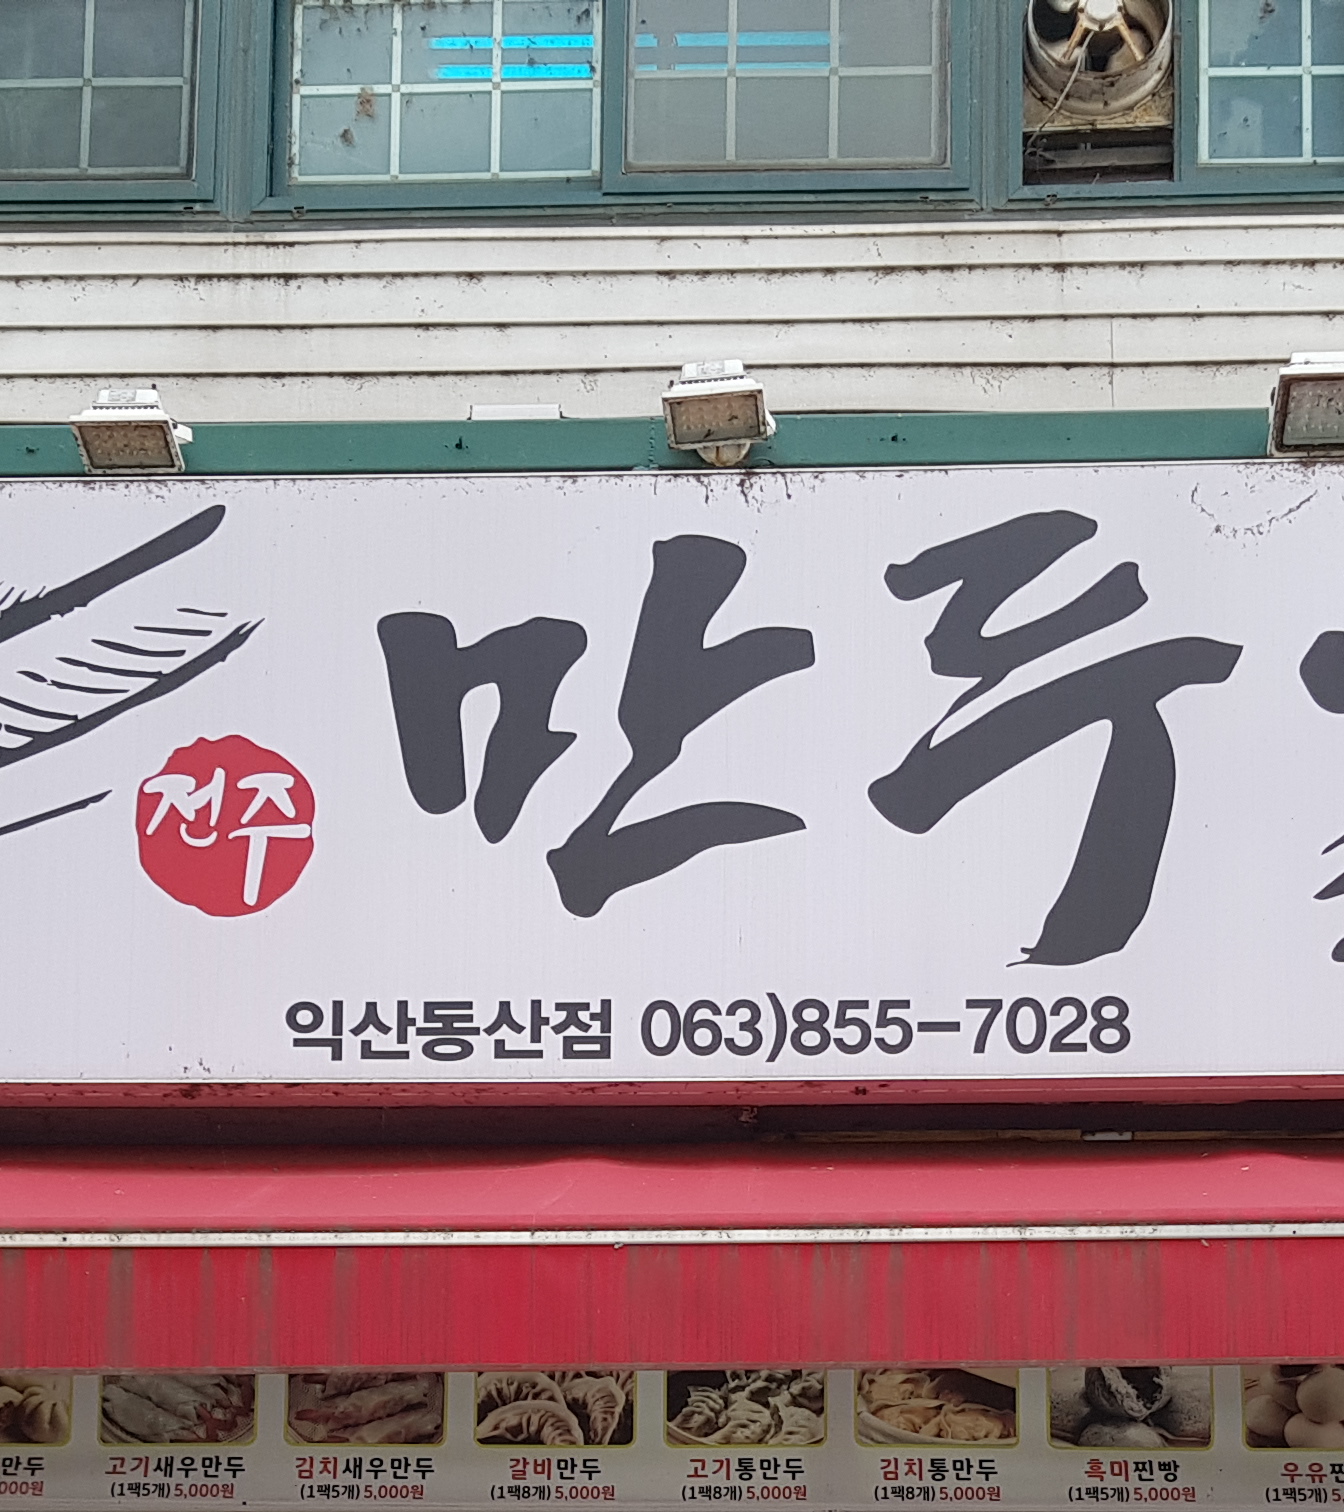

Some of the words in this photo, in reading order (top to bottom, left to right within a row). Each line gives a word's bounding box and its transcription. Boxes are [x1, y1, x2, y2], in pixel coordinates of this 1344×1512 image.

[145, 767, 311, 907] 전주
[286, 999, 611, 1061] 익산동산점
[641, 993, 1130, 1062] 063)855-7028
[105, 1456, 245, 1478] 고기새우만두
[296, 1456, 434, 1479] 김치새우만두
[510, 1457, 601, 1480] 갈비만두
[687, 1457, 804, 1481] 고기통만두
[881, 1458, 998, 1481] 김치통만두
[1085, 1459, 1180, 1482] 흑미찐빵
[111, 1482, 170, 1498] (1팩5개)
[174, 1483, 234, 1499] 5,000원
[296, 1484, 360, 1500] (1팩5개)
[364, 1485, 423, 1500] 5,000원
[491, 1485, 551, 1500] (1팩8개)
[555, 1485, 615, 1500] 5,000원
[682, 1485, 742, 1501] (1팩8개)
[747, 1485, 807, 1500] 5,000원
[875, 1486, 935, 1501] (1팩8개)
[940, 1486, 1000, 1501] 5,000원
[1069, 1487, 1129, 1502] (1팩5개)
[1134, 1487, 1196, 1502] 5,000원
[1266, 1487, 1327, 1503] (1팩5개)
